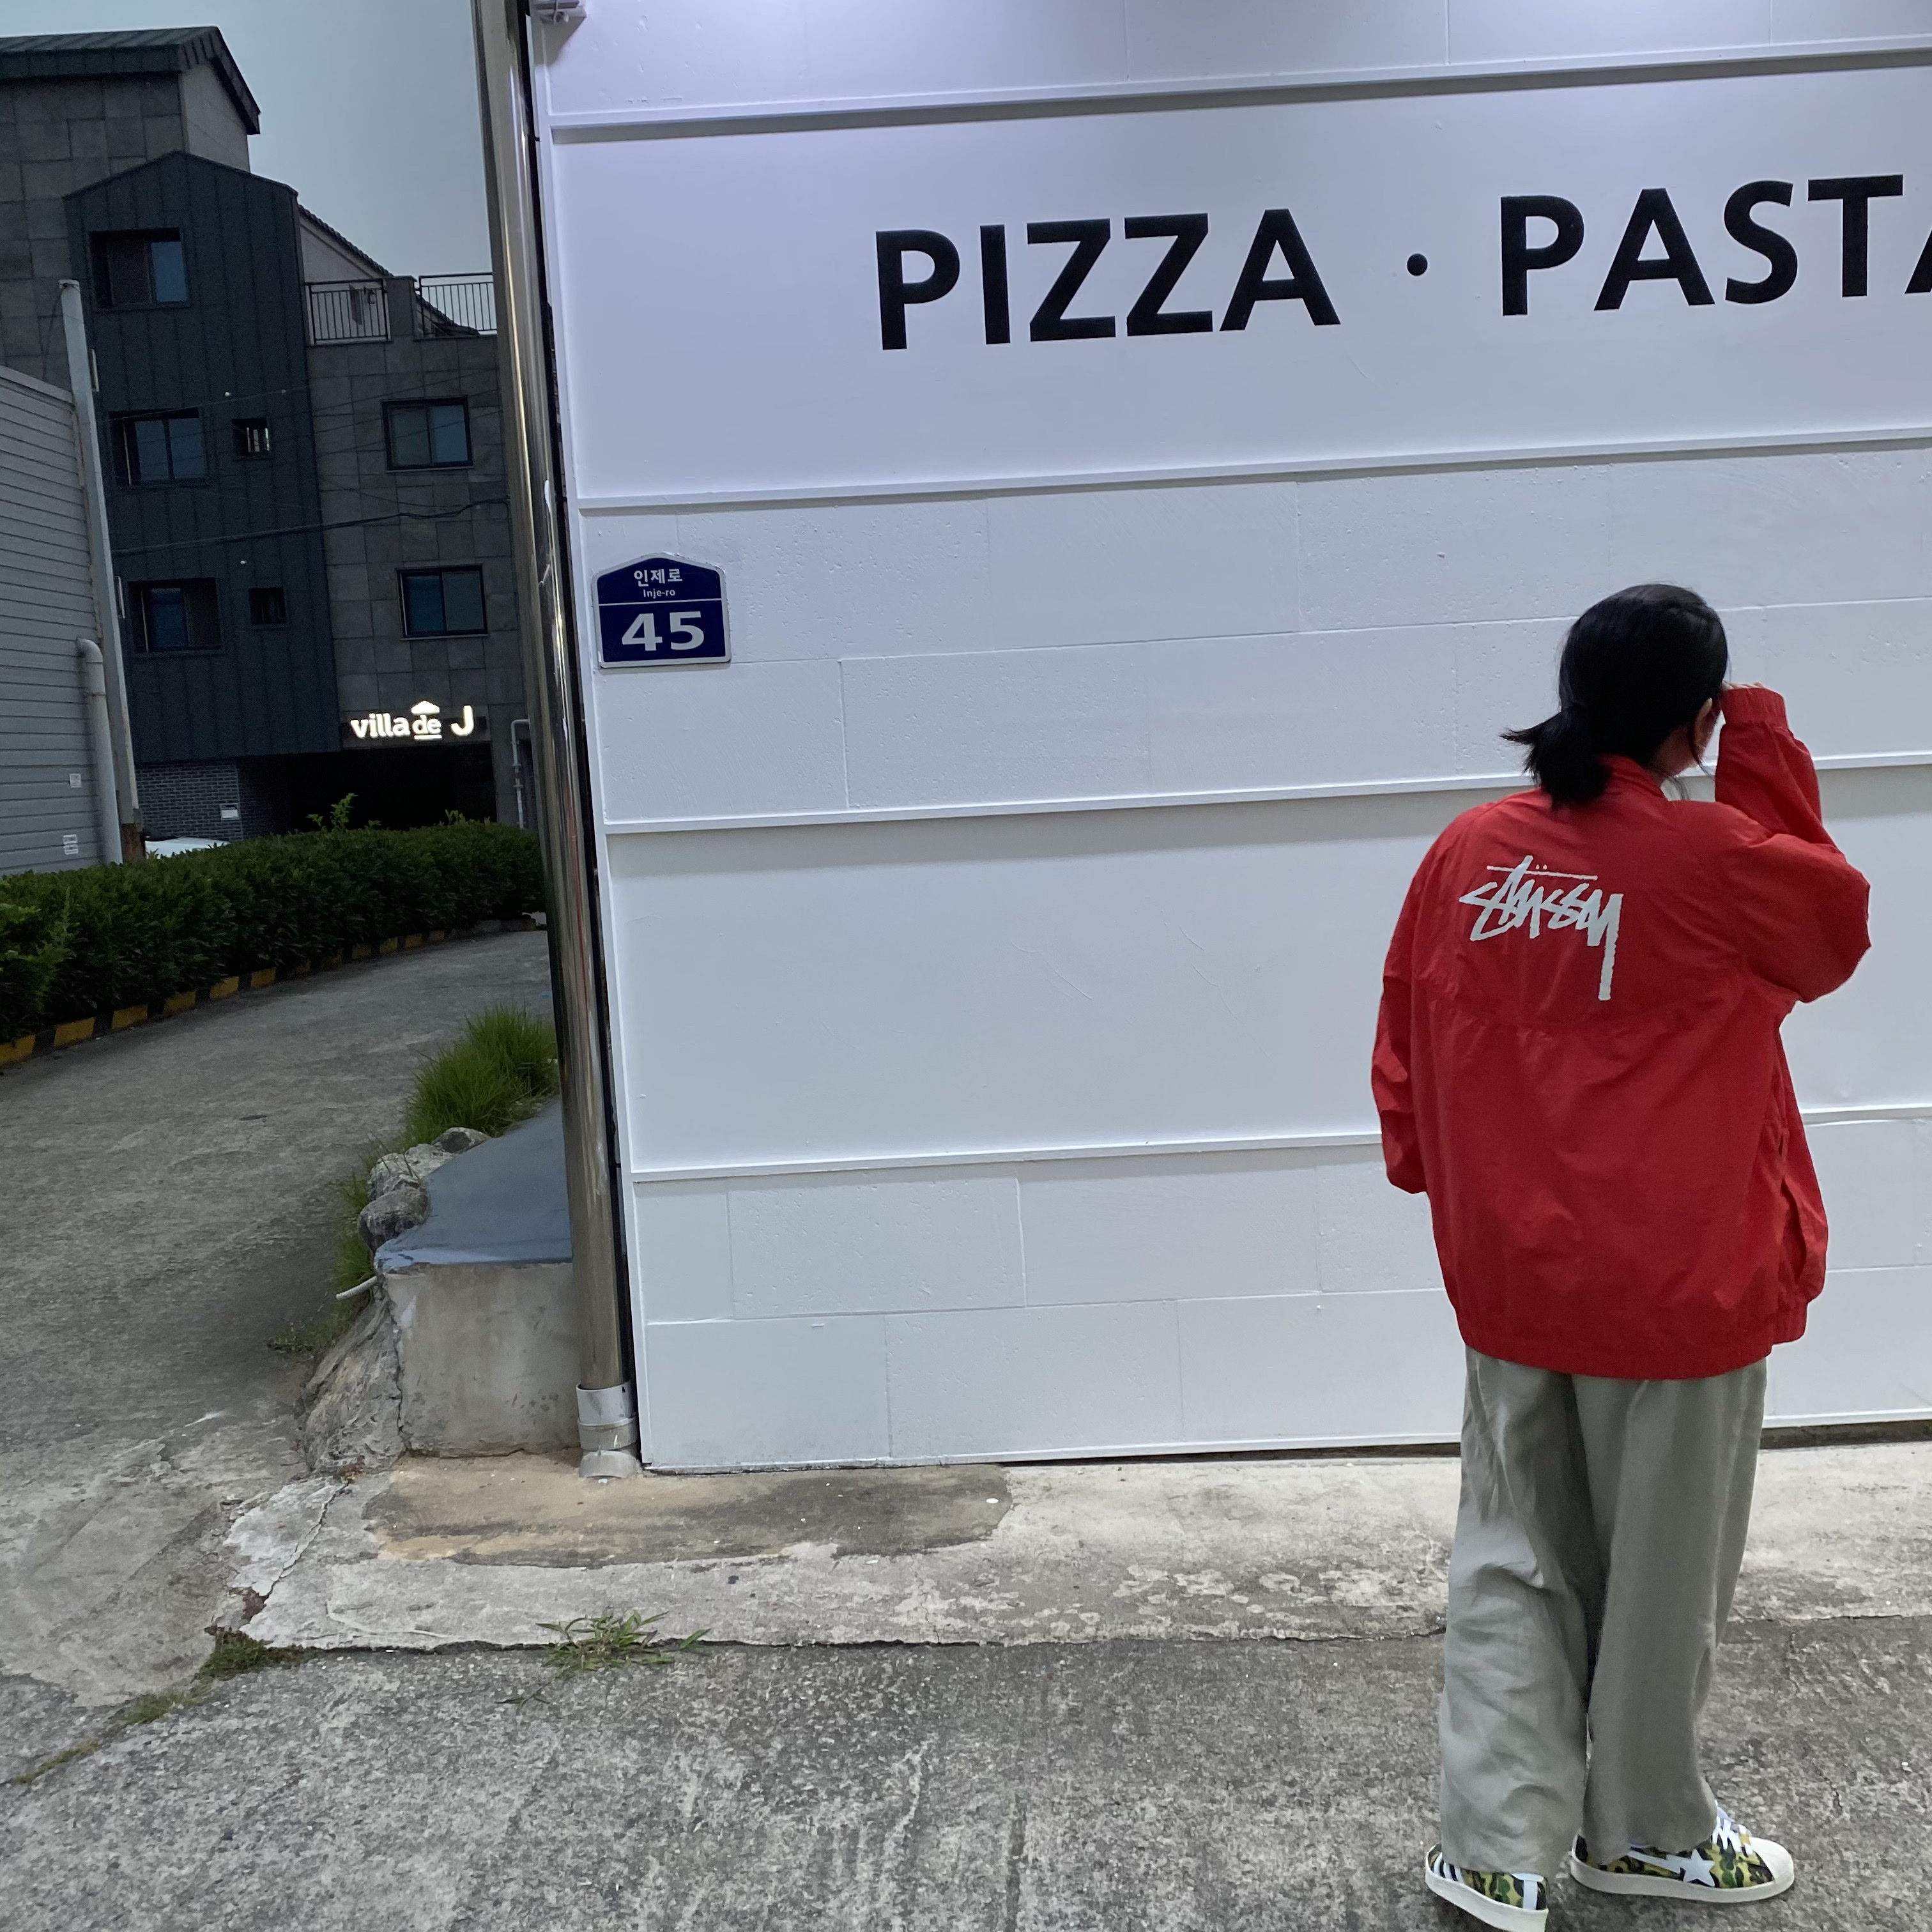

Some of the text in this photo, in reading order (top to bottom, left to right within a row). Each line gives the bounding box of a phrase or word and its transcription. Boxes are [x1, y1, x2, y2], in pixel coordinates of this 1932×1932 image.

[875, 208, 1342, 350] PIZZA
[1500, 174, 1932, 316] PAST
[633, 568, 683, 587] 인제로
[643, 588, 676, 599] Inje-ro
[621, 610, 705, 652] 45
[349, 704, 475, 739] villa de J
